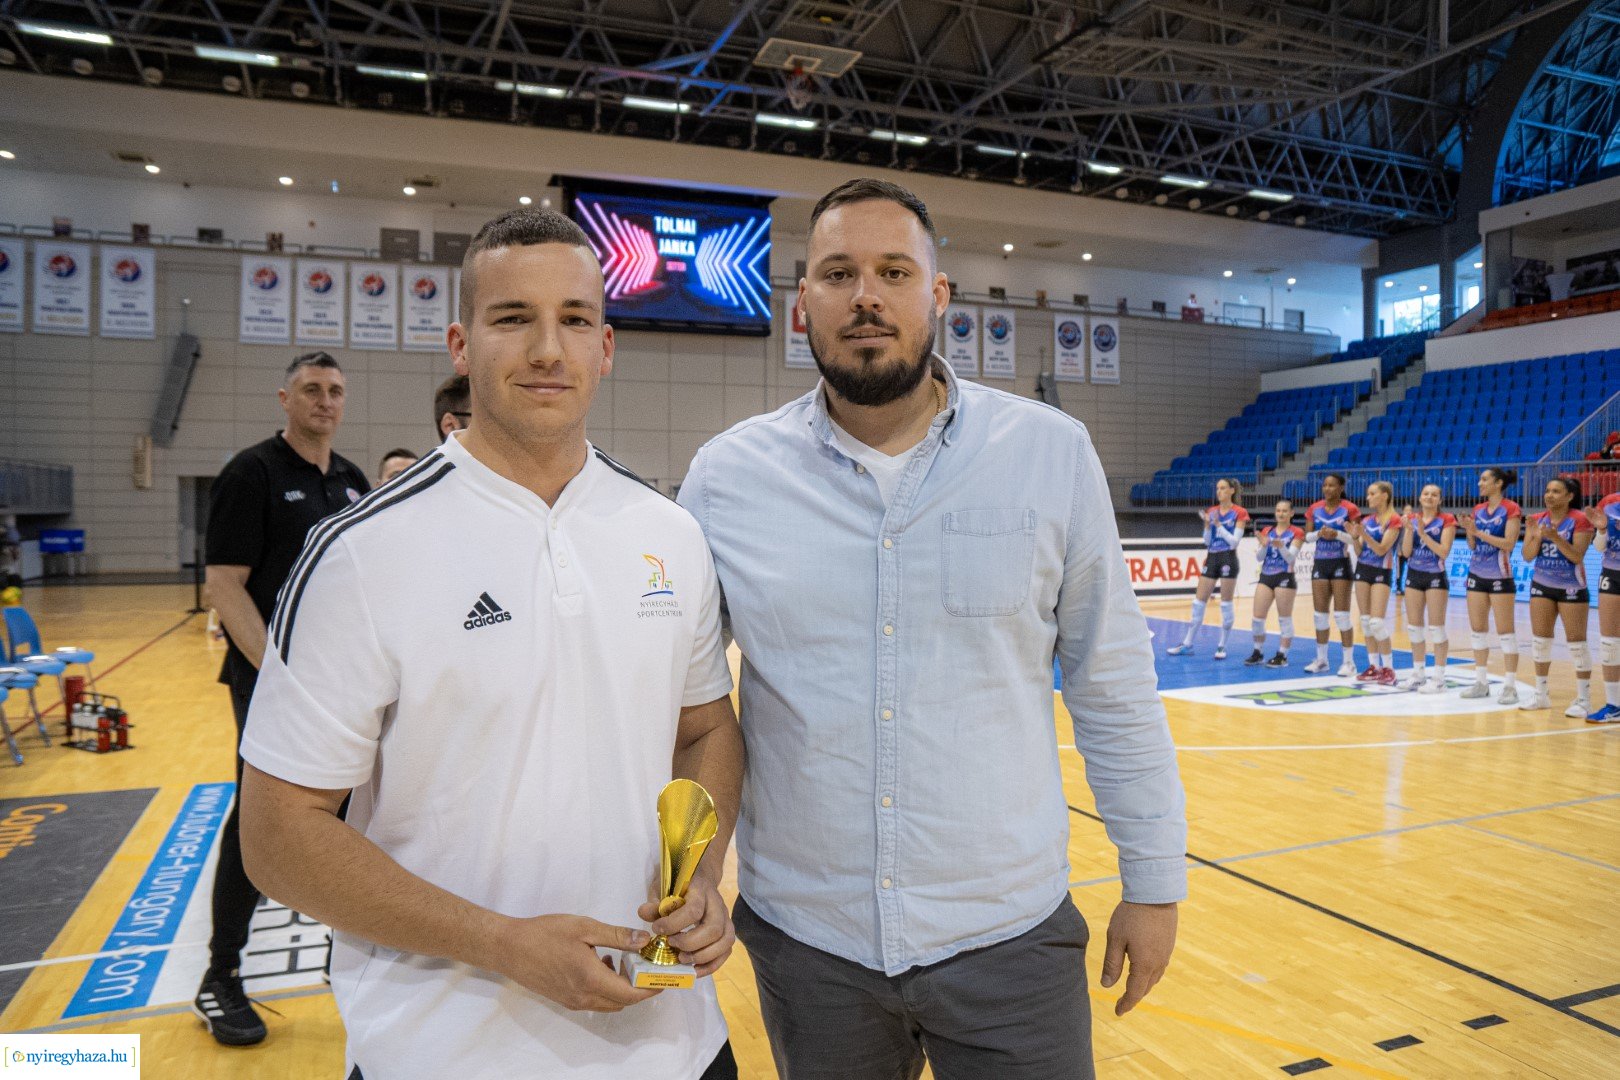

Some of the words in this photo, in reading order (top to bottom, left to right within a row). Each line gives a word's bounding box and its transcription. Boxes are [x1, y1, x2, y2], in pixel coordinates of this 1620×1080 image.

[654, 216, 697, 235] TOLNAI
[658, 238, 696, 256] JANKA
[1541, 543, 1558, 558] 22
[1125, 557, 1207, 582] RABA
[463, 608, 512, 631] adidas
